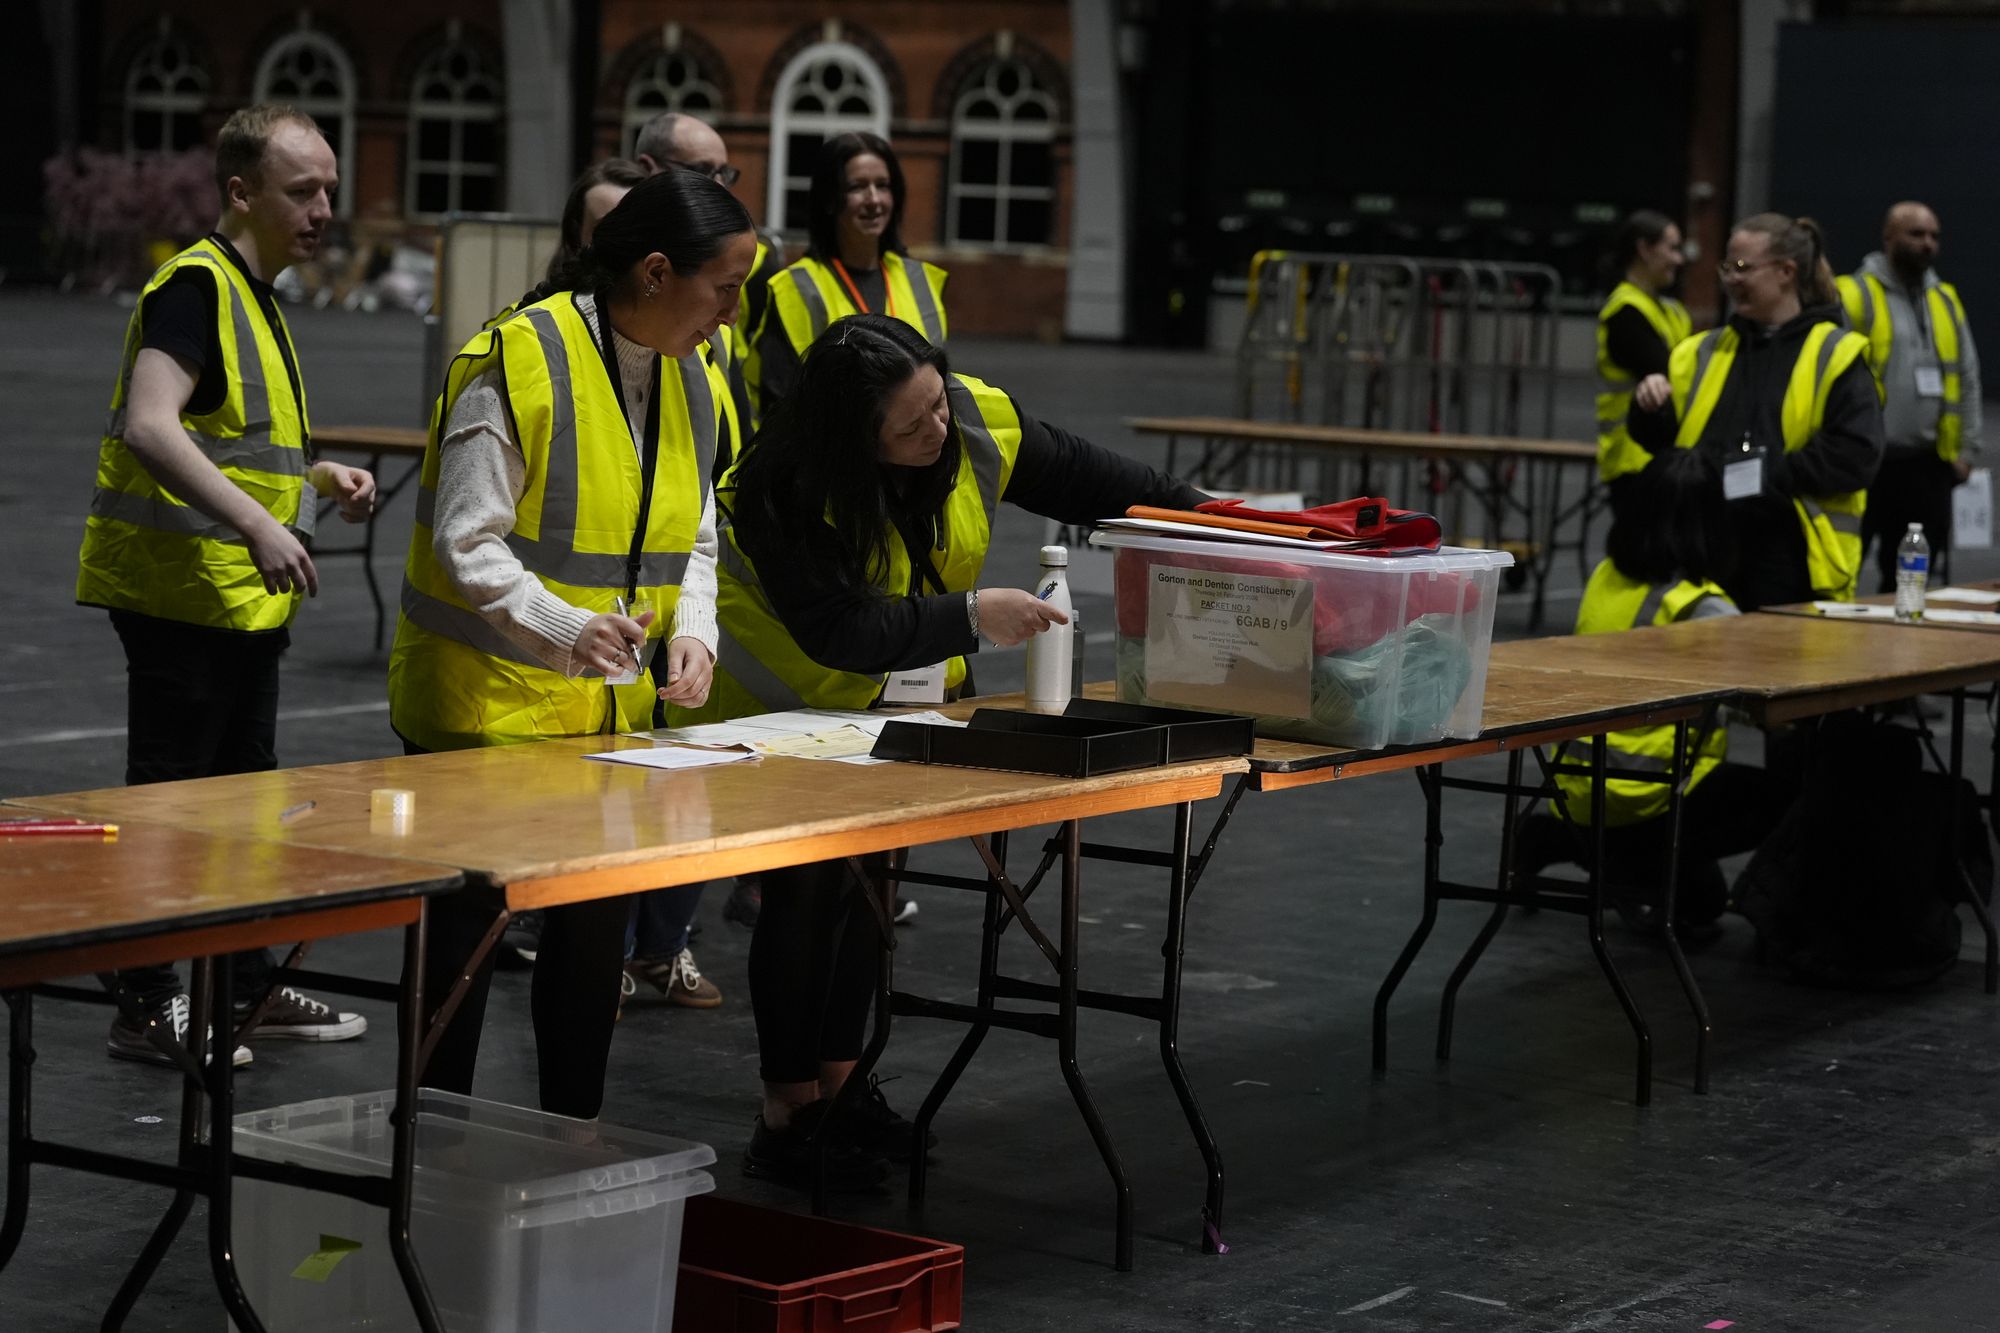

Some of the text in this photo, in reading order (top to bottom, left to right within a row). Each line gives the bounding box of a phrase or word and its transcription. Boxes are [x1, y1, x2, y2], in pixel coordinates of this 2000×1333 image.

[1056, 525, 1112, 549] AR
[1158, 573, 1296, 597] Gorton and Denton Constituency
[1201, 600, 1231, 611] PACKET
[1231, 603, 1245, 611] NO.
[1236, 614, 1271, 629] 6GAB
[1273, 618, 1278, 630] /
[1280, 620, 1288, 631] 9
